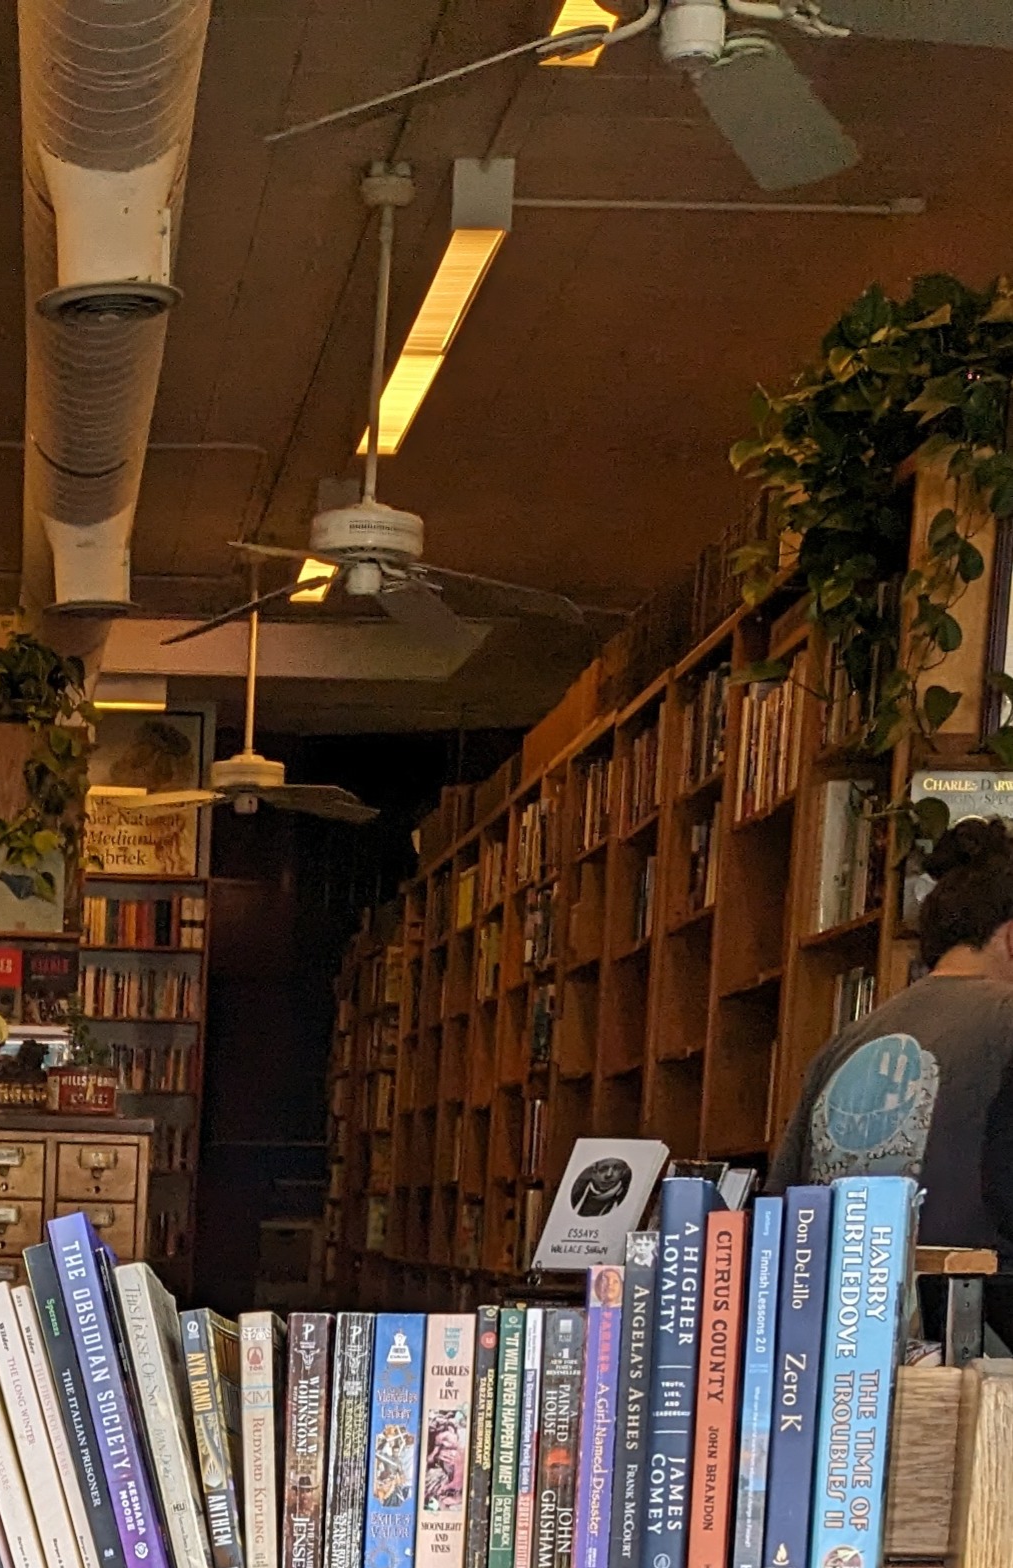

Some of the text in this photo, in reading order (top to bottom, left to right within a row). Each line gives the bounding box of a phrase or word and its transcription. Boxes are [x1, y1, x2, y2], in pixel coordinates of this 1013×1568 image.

[567, 1228, 599, 1238] ESSAYS
[791, 1209, 815, 1310] Don DeLillo
[659, 1234, 680, 1334] LOYALTY
[678, 1222, 699, 1345] A HIGHER
[836, 1187, 868, 1359] TURTLEDOVE
[866, 1226, 892, 1321] HARRY
[62, 1240, 131, 1470] THE OBSIDIAN SOCIETY
[707, 1230, 733, 1404] CITRUS COUNTY
[187, 1352, 212, 1411] AYN RAND
[439, 1390, 459, 1400] LINT
[625, 1285, 650, 1450] ANGELA'S ASHES
[664, 1390, 682, 1398] LIES,
[780, 1353, 806, 1432] Zero K
[252, 1417, 267, 1544] RUDYARD KIPLING
[703, 1426, 719, 1532] JOHN BRANDON
[850, 1370, 879, 1531] THE TIME OF
[118, 1490, 135, 1532] MOORE
[126, 1481, 146, 1536] KESHARA
[207, 1494, 233, 1548] ANTHEM
[421, 1521, 462, 1531] MOONLIGHT
[538, 1490, 556, 1568] GRISHAM
[557, 1507, 573, 1553] JOHN
[646, 1453, 666, 1535] COMEY
[667, 1457, 686, 1530] JAMES
[431, 1544, 450, 1553] VINES
[434, 1534, 448, 1542] AND
